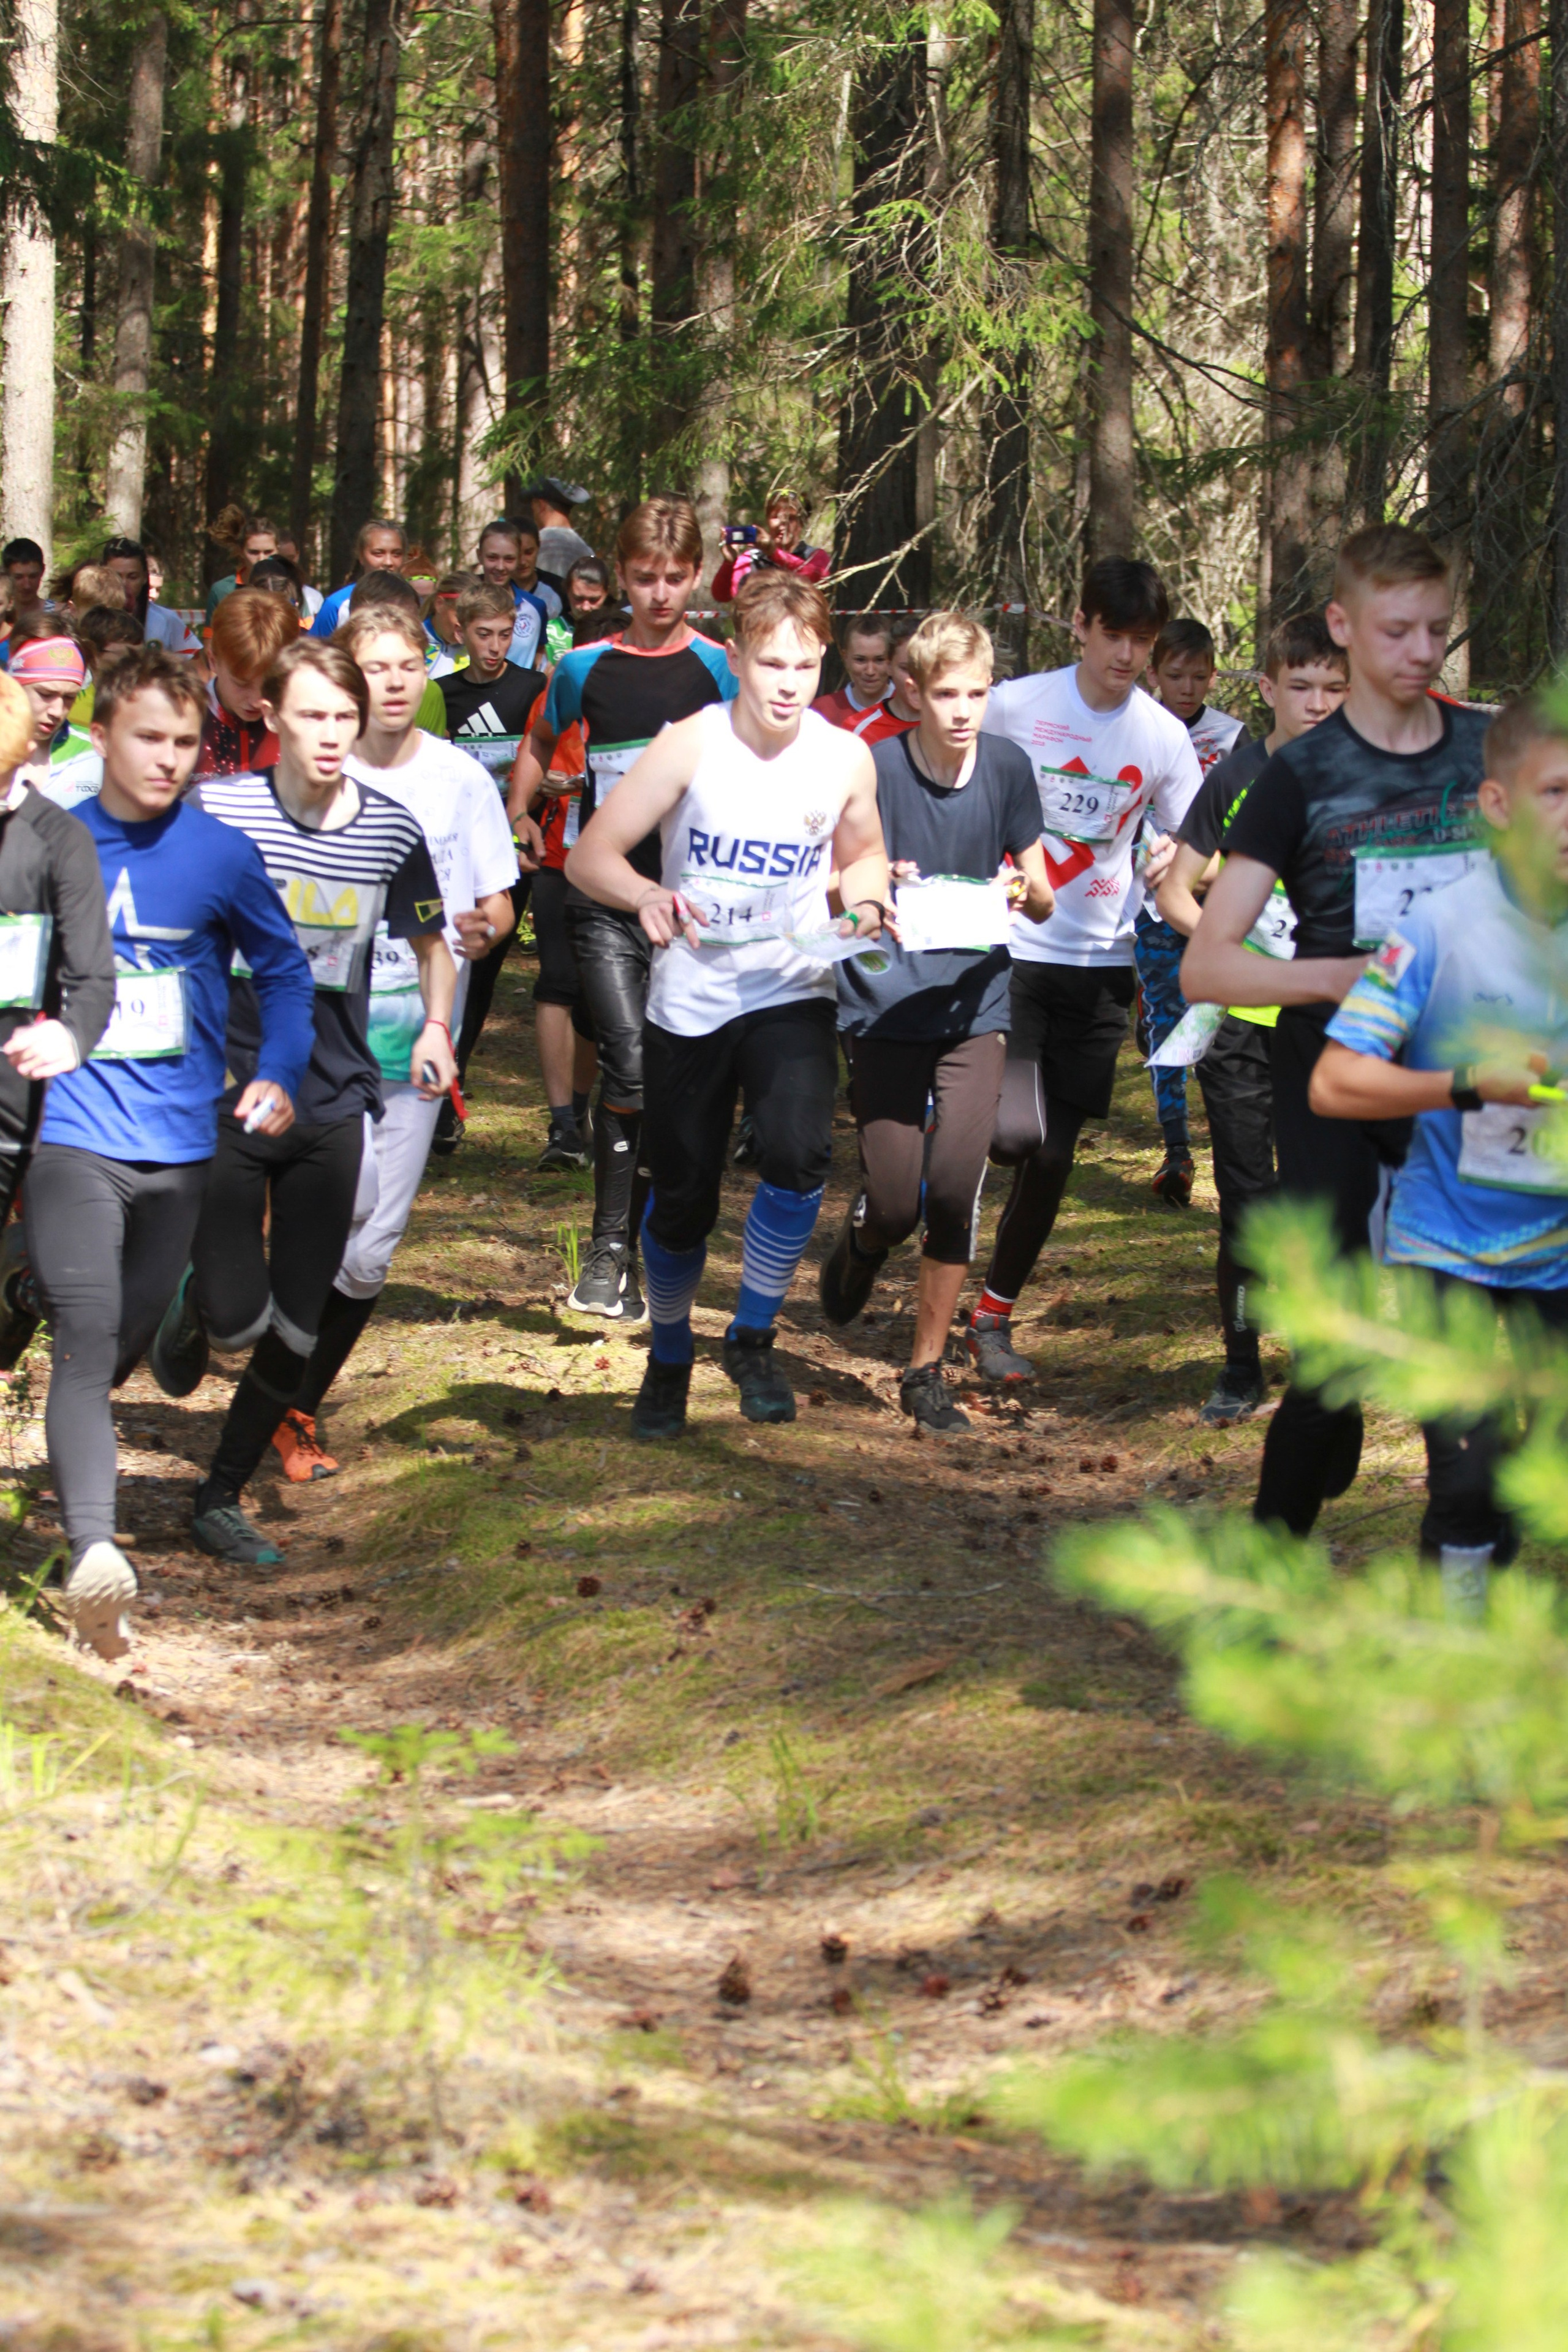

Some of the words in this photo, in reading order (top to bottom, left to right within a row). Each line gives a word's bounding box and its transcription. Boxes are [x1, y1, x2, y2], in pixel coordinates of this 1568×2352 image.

[1058, 793, 1099, 815] 229
[688, 827, 825, 877] RUSSIA
[287, 878, 358, 925] ILA
[709, 903, 752, 925] 214
[372, 950, 399, 970] 39
[116, 998, 146, 1021] 19
[1508, 1126, 1528, 1156] 2
